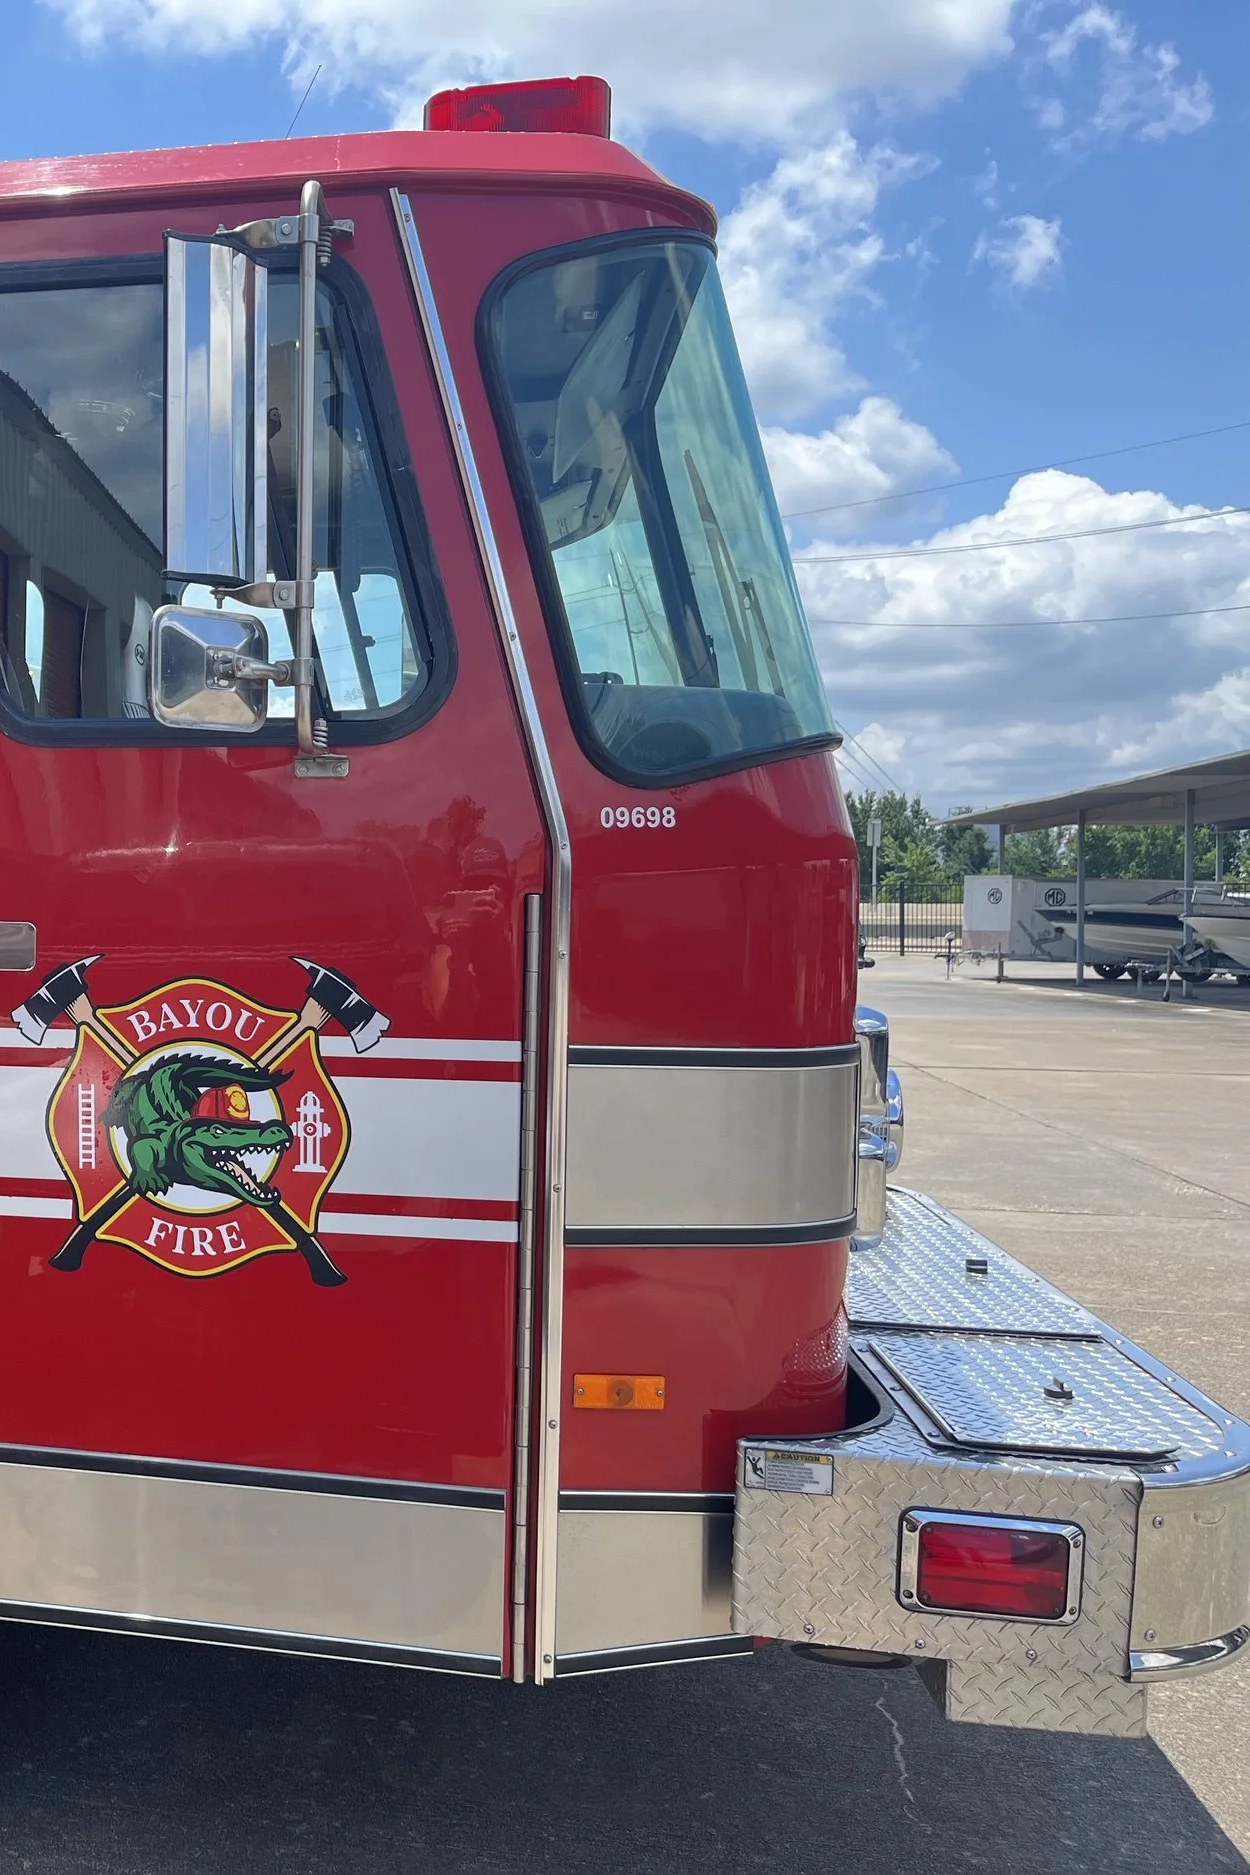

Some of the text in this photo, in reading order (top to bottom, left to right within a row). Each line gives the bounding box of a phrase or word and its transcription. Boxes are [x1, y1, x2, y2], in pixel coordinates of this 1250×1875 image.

[600, 806, 676, 828] 09698
[988, 889, 1002, 904] MG
[1046, 889, 1064, 905] MG
[126, 999, 265, 1042] BAYOU
[144, 1217, 246, 1256] FIRE
[781, 1452, 820, 1463] CAUTION
